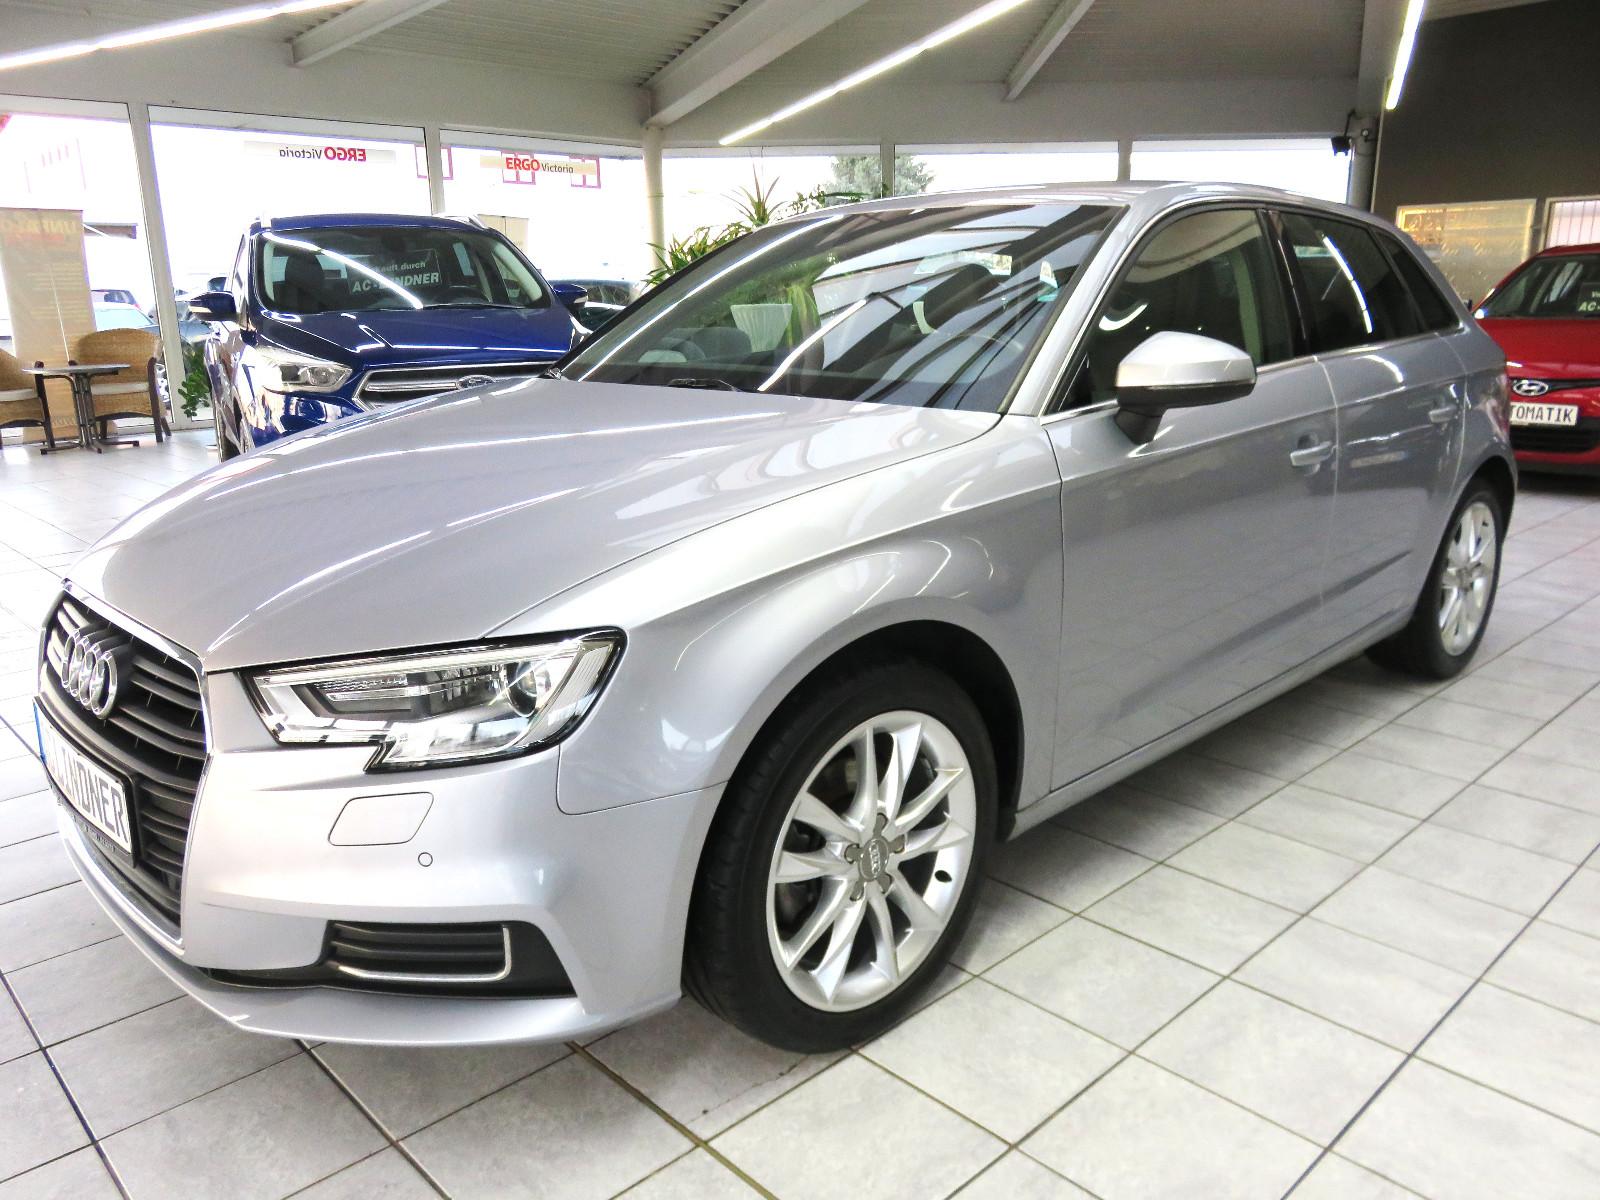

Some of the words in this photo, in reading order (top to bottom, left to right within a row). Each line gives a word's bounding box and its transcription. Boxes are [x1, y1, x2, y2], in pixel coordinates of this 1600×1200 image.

[506, 157, 540, 171] ERGO
[541, 163, 574, 173] Victoria
[400, 260, 426, 271] durch
[352, 272, 440, 292] AC-NDNER
